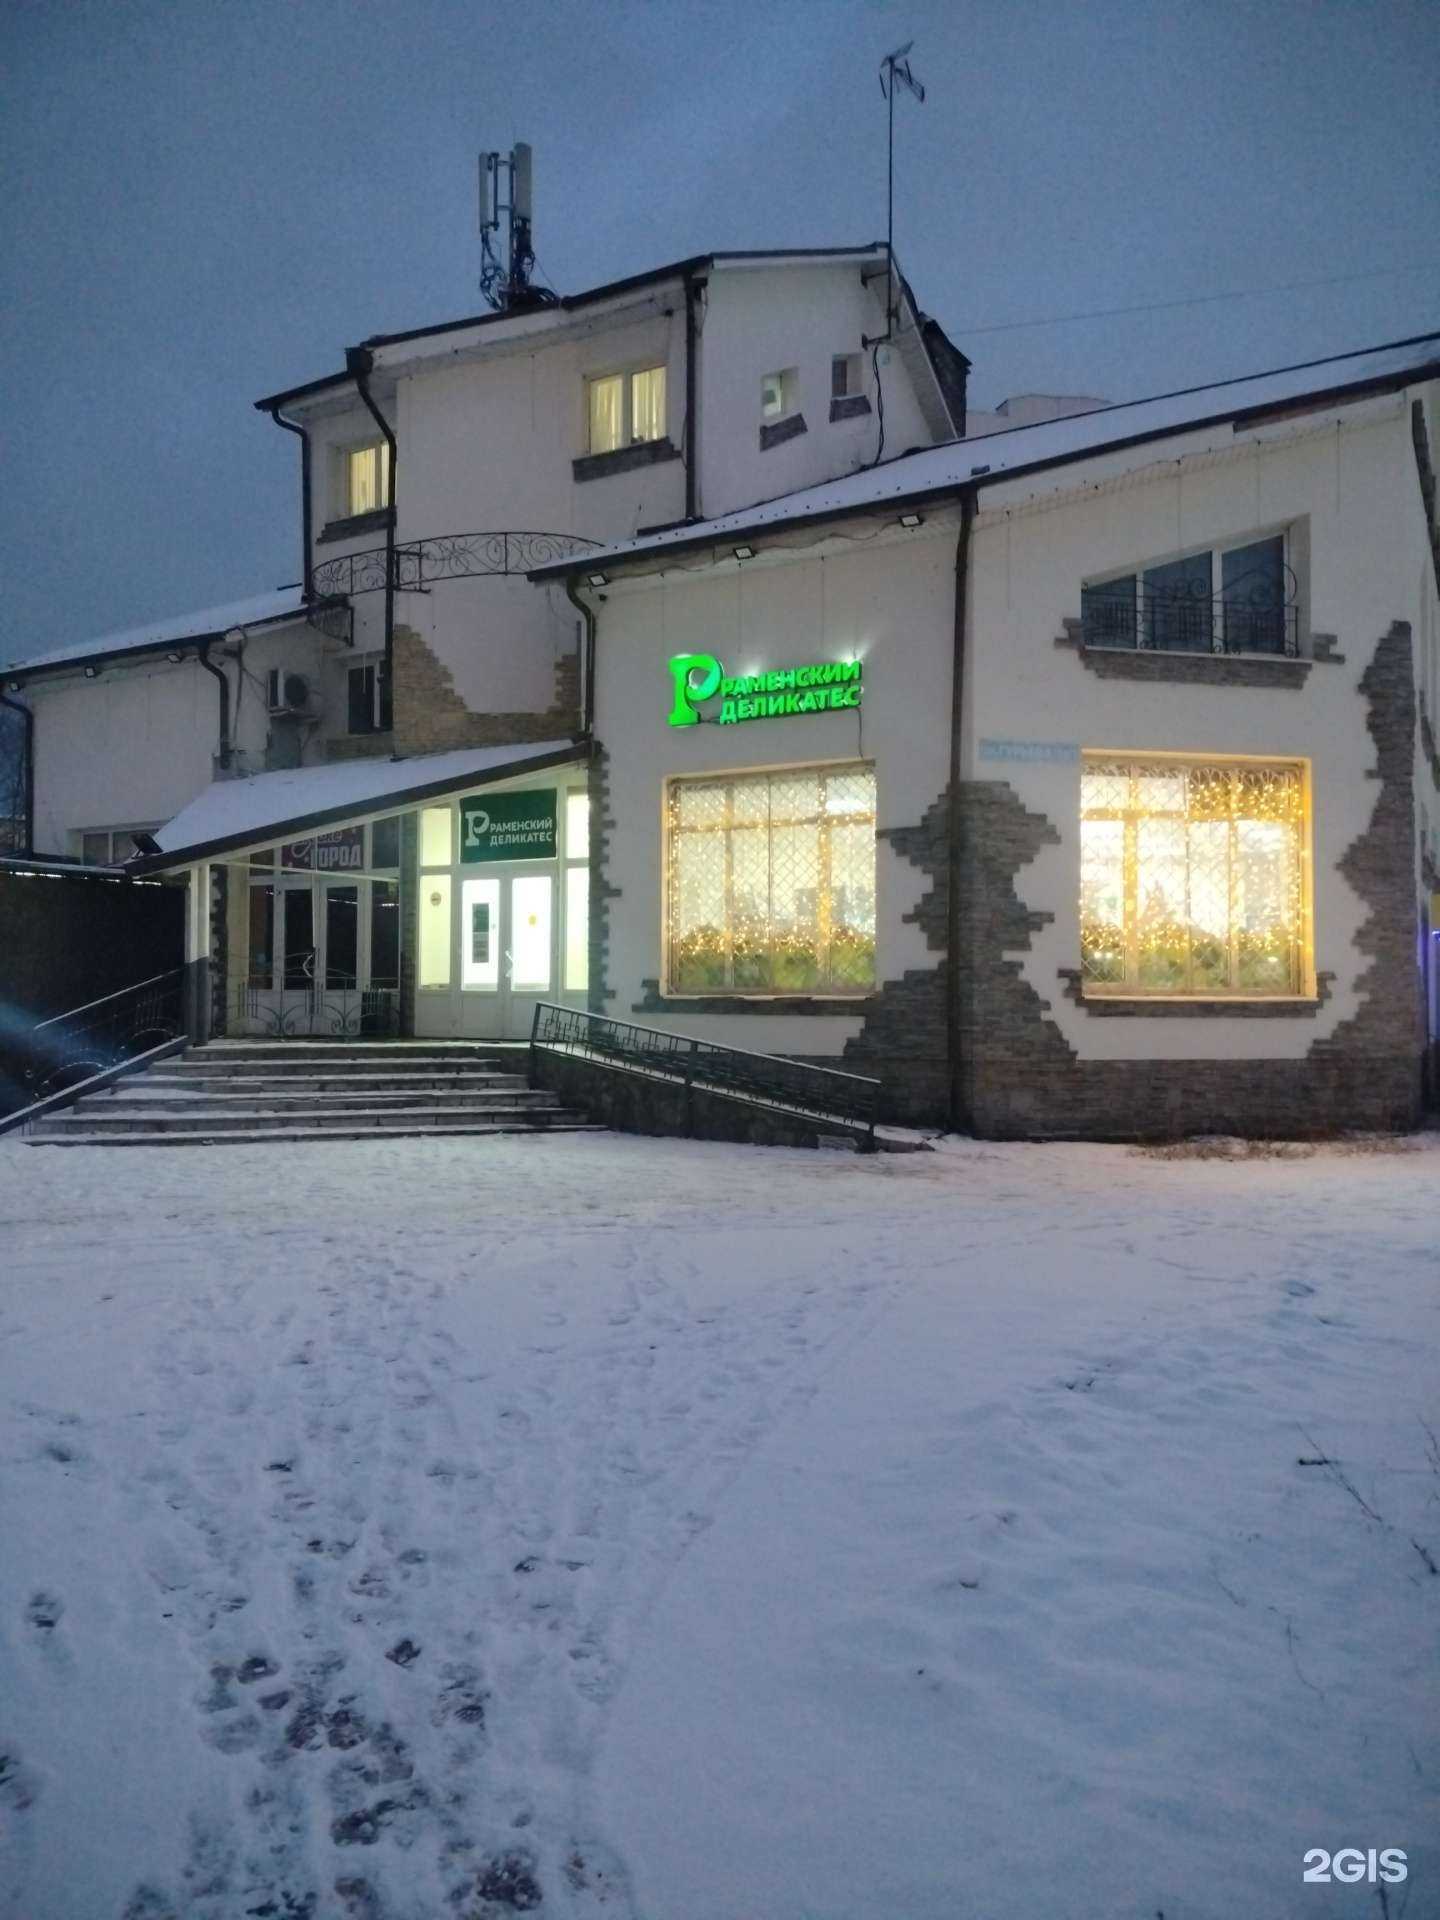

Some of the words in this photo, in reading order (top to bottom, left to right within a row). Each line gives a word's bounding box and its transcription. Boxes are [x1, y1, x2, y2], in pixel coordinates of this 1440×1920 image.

[720, 661, 862, 698] РАМЕНСКИЙ
[719, 685, 862, 725] ДЕЛИКАТЕС
[490, 817, 553, 833] РАМЕНСКИЙ
[490, 832, 553, 847] ДЕЛИКАТЕС
